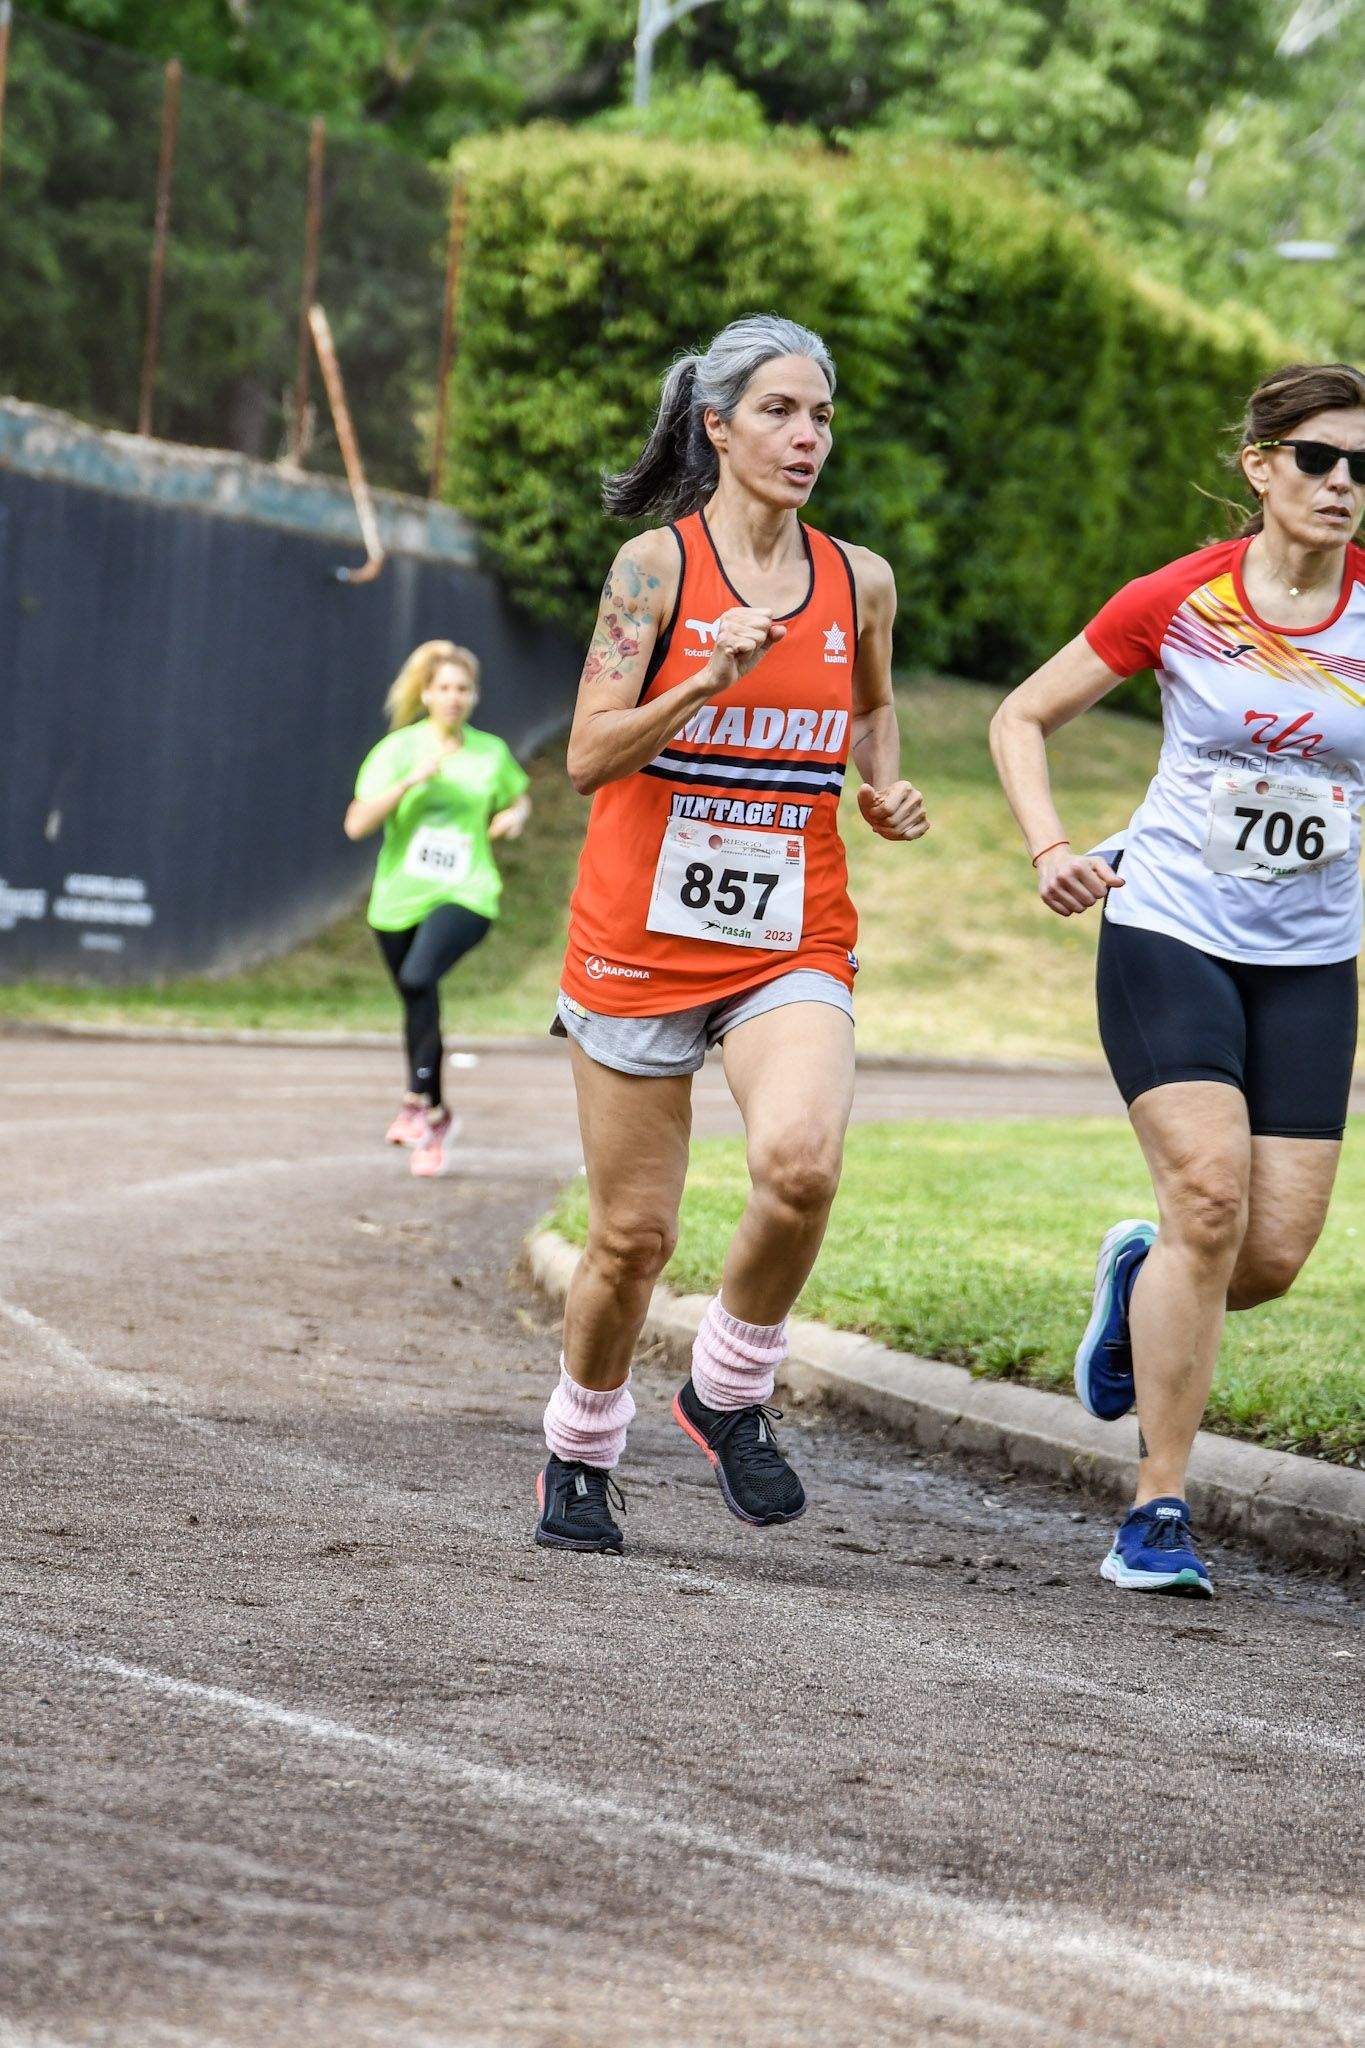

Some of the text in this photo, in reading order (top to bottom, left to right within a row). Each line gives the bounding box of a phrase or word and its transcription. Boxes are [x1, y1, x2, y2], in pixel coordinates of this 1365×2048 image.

[674, 705, 848, 753] MADRID
[672, 793, 778, 826] VINTAGE
[1234, 806, 1326, 861] 706
[680, 862, 780, 921] 857
[721, 927, 751, 939] rasán
[764, 930, 793, 942] 2023
[602, 965, 650, 979] MAPOMA
[1156, 1507, 1181, 1517] HOKA
